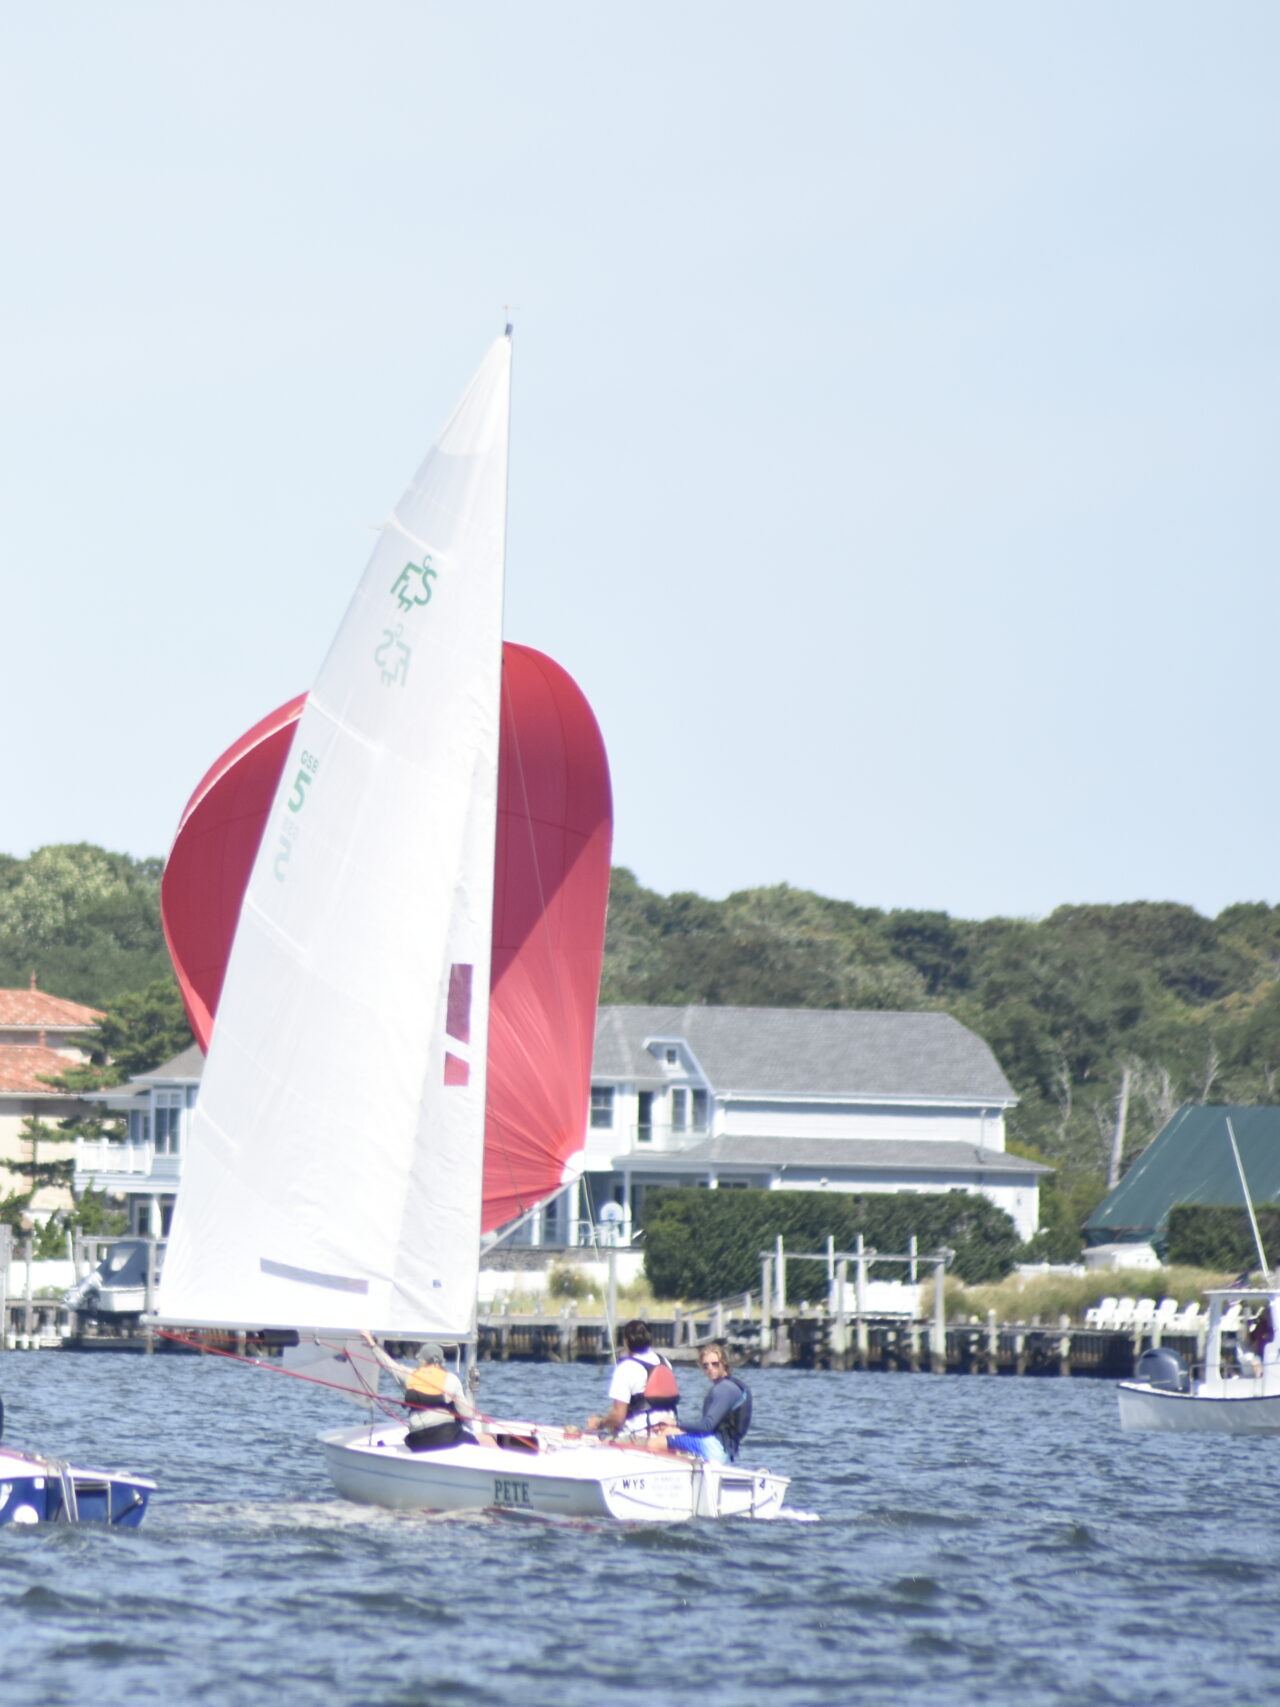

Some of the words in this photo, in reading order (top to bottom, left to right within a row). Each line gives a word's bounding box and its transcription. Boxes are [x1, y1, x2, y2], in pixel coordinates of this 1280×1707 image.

[287, 768, 313, 814] 5
[493, 1479, 530, 1503] PETE
[622, 1478, 646, 1490] WYS
